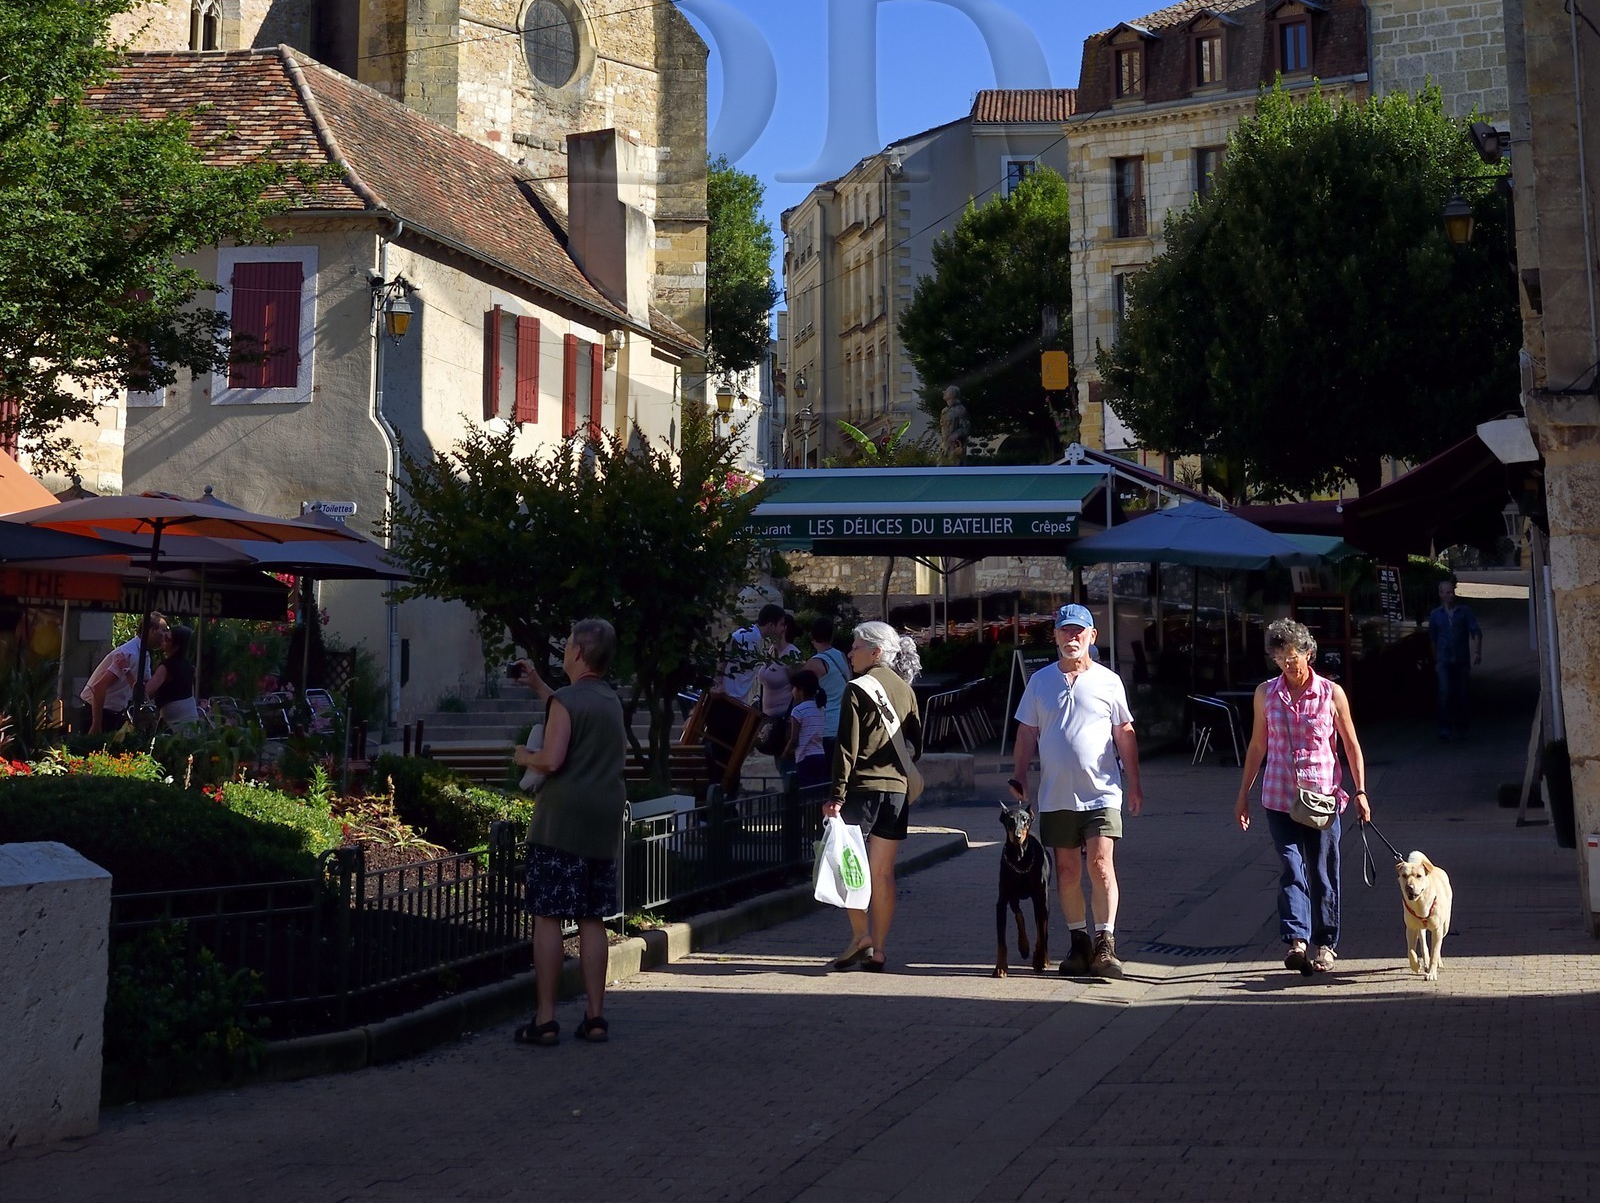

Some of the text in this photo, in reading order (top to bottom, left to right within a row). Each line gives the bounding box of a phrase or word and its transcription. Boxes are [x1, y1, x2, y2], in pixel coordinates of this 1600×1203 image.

[322, 504, 353, 513] Toilettes
[808, 519, 834, 535] LES
[843, 516, 903, 535] DÉLICES
[911, 518, 935, 534] DU
[943, 517, 1013, 534] BATELIER
[1031, 520, 1071, 536] Crêpes
